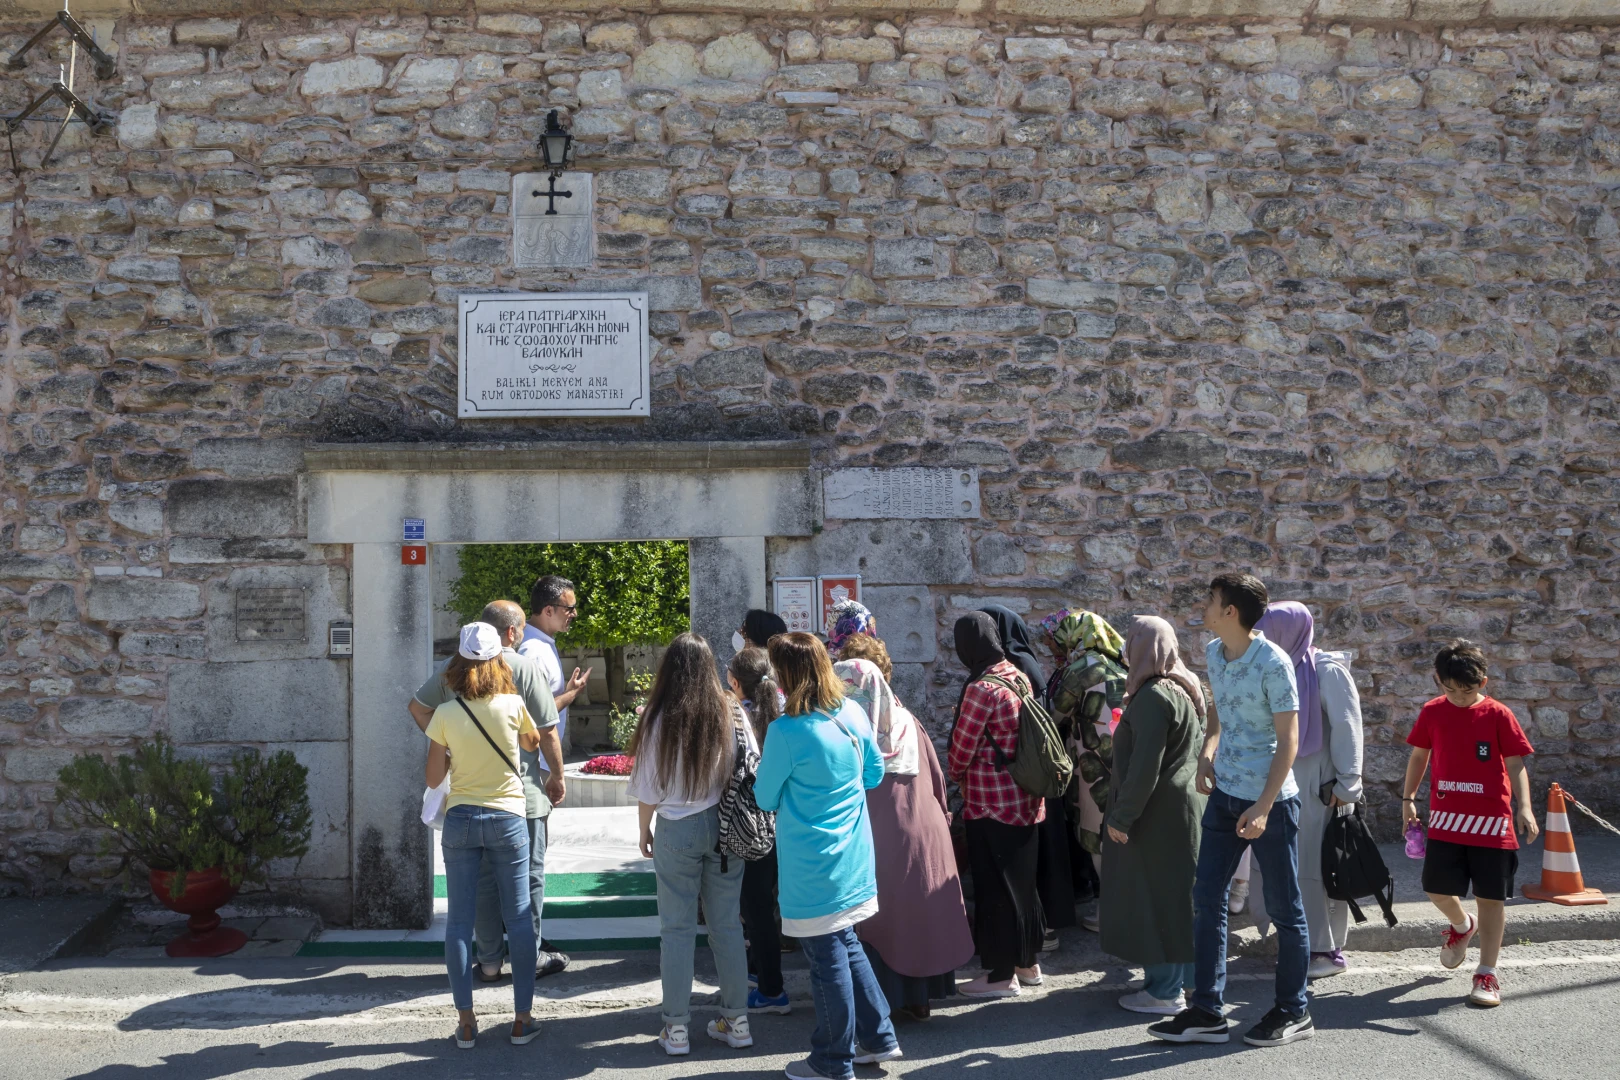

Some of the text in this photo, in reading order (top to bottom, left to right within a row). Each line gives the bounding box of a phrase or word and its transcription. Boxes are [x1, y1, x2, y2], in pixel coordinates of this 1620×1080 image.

[542, 377, 582, 387] MERYEM
[588, 377, 608, 387] ANA
[481, 389, 624, 400] RUM ORTODOKS MANASTIRI
[410, 550, 417, 560] 3
[1438, 780, 1484, 794] DREAMS MONSTER
